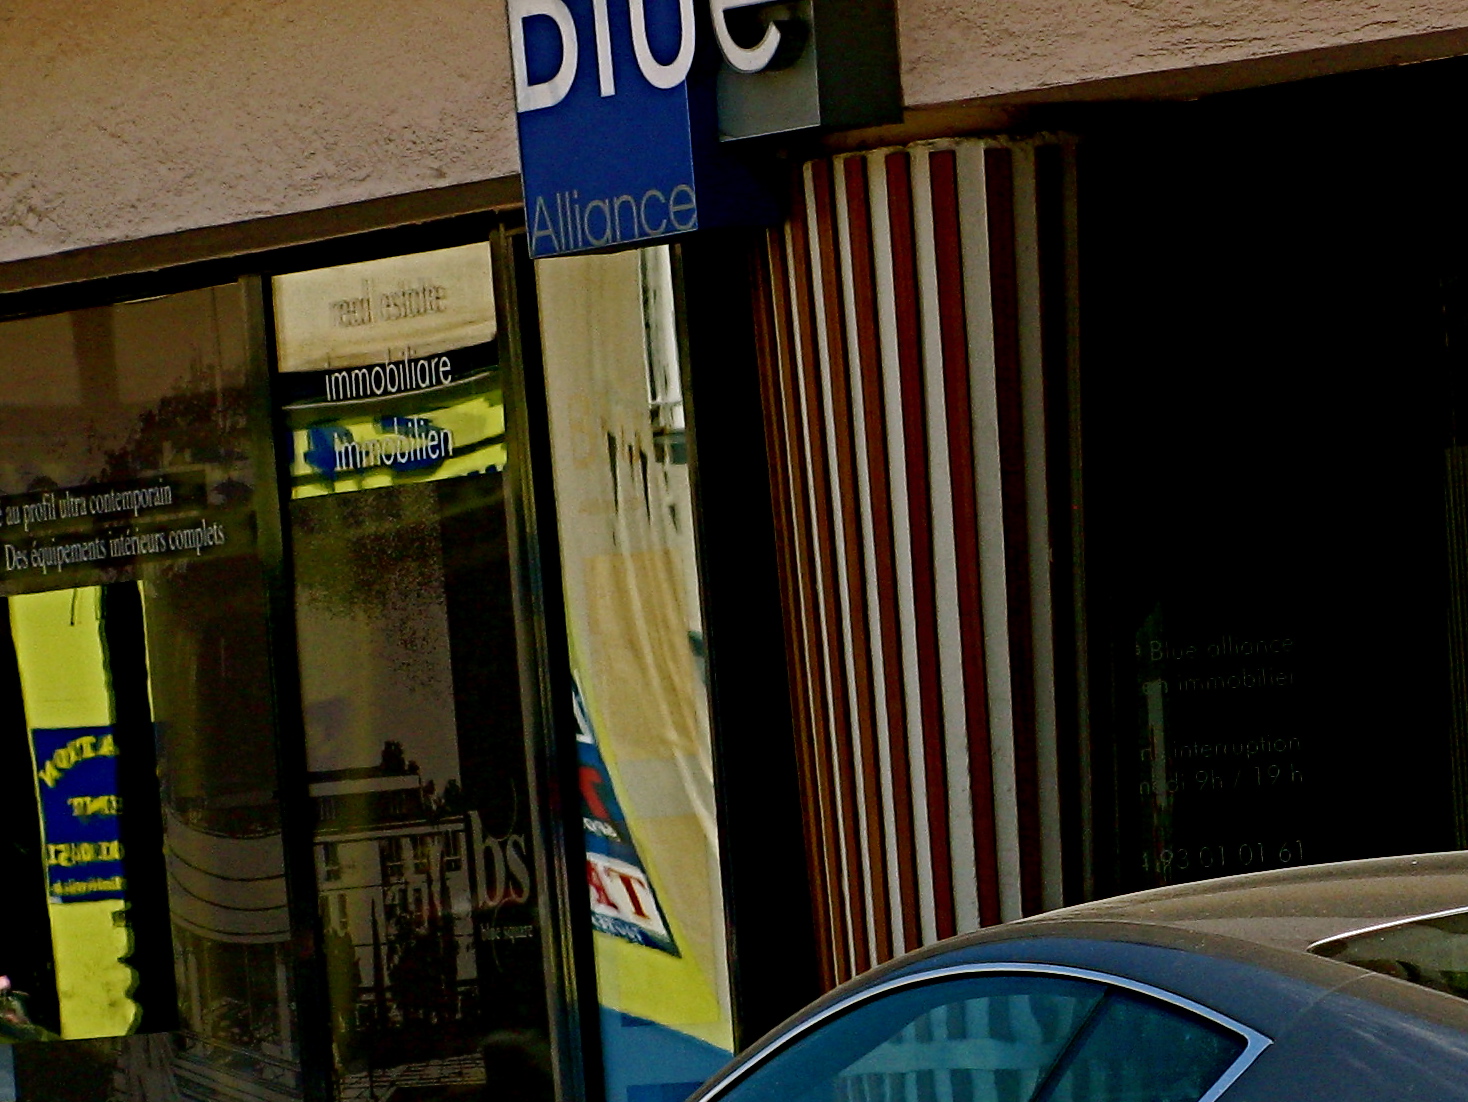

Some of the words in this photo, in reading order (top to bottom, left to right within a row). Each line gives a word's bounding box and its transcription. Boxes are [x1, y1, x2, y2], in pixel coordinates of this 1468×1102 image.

[532, 184, 697, 254] Alliance
[324, 353, 453, 401] immobiliare
[332, 415, 454, 471] immobilien
[22, 492, 57, 532] profil
[58, 490, 87, 519] ultra
[89, 478, 174, 517] contemporain
[4, 544, 29, 571] Des
[30, 537, 108, 575] équipements
[108, 527, 168, 558] intérieurs
[168, 518, 226, 556] complets
